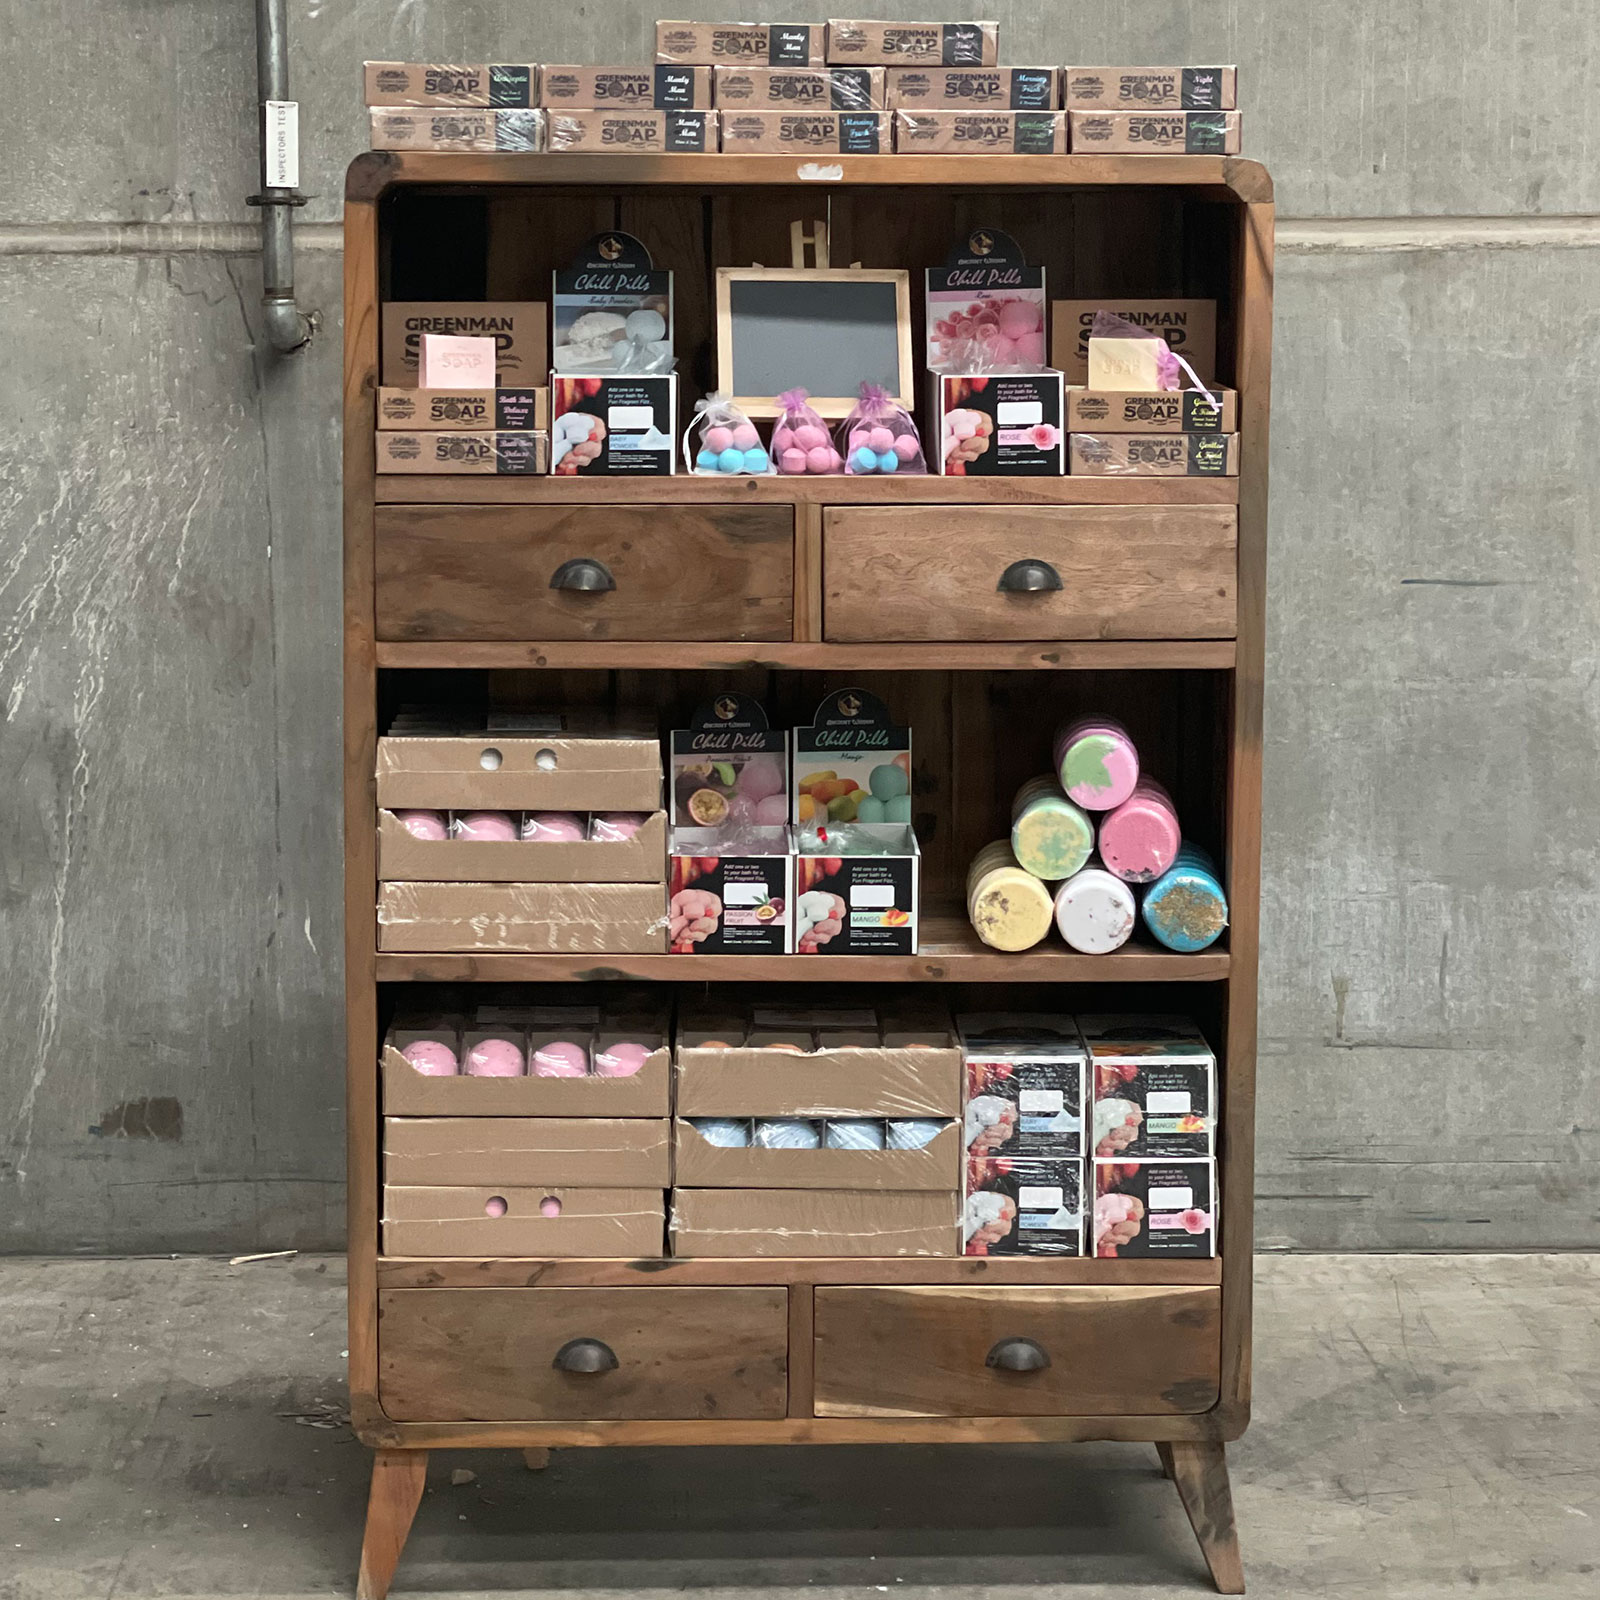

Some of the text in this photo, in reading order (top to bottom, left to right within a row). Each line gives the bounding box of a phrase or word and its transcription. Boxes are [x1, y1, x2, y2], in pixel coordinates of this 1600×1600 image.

[713, 31, 767, 40] GREENMAN
[884, 30, 938, 38] GREENMAN
[712, 40, 767, 54] SOAP
[595, 74, 650, 82] GREENMAN
[769, 76, 824, 84] GREENMAN
[946, 74, 1000, 82] GREENMAN
[424, 78, 480, 94] SOAP
[594, 83, 650, 98] SOAP
[769, 84, 824, 99] SOAP
[945, 82, 1000, 97] SOAP
[1120, 84, 1175, 99] SOAP
[602, 120, 657, 128] GREENMAN
[780, 116, 835, 124] GREENMAN
[954, 117, 1009, 125] GREENMAN
[431, 125, 486, 140] SOAP
[602, 128, 657, 143] SOAP
[780, 125, 835, 140] SOAP
[954, 126, 1009, 140] SOAP
[1129, 126, 1184, 142] SOAP
[278, 105, 286, 184] INSPECTORS TEST
[574, 274, 650, 292] Chill Pills
[947, 268, 1022, 286] Chill Pills
[405, 317, 514, 332] GREENMAN
[405, 334, 514, 358] SP
[431, 397, 486, 405] GREENMAN
[430, 406, 486, 420] SOAP
[1124, 405, 1179, 420] SOAP
[436, 445, 491, 460] SOAP
[1128, 448, 1182, 464] SOAP
[692, 732, 766, 750] Chill Pills
[815, 730, 890, 747] Chill Pills
